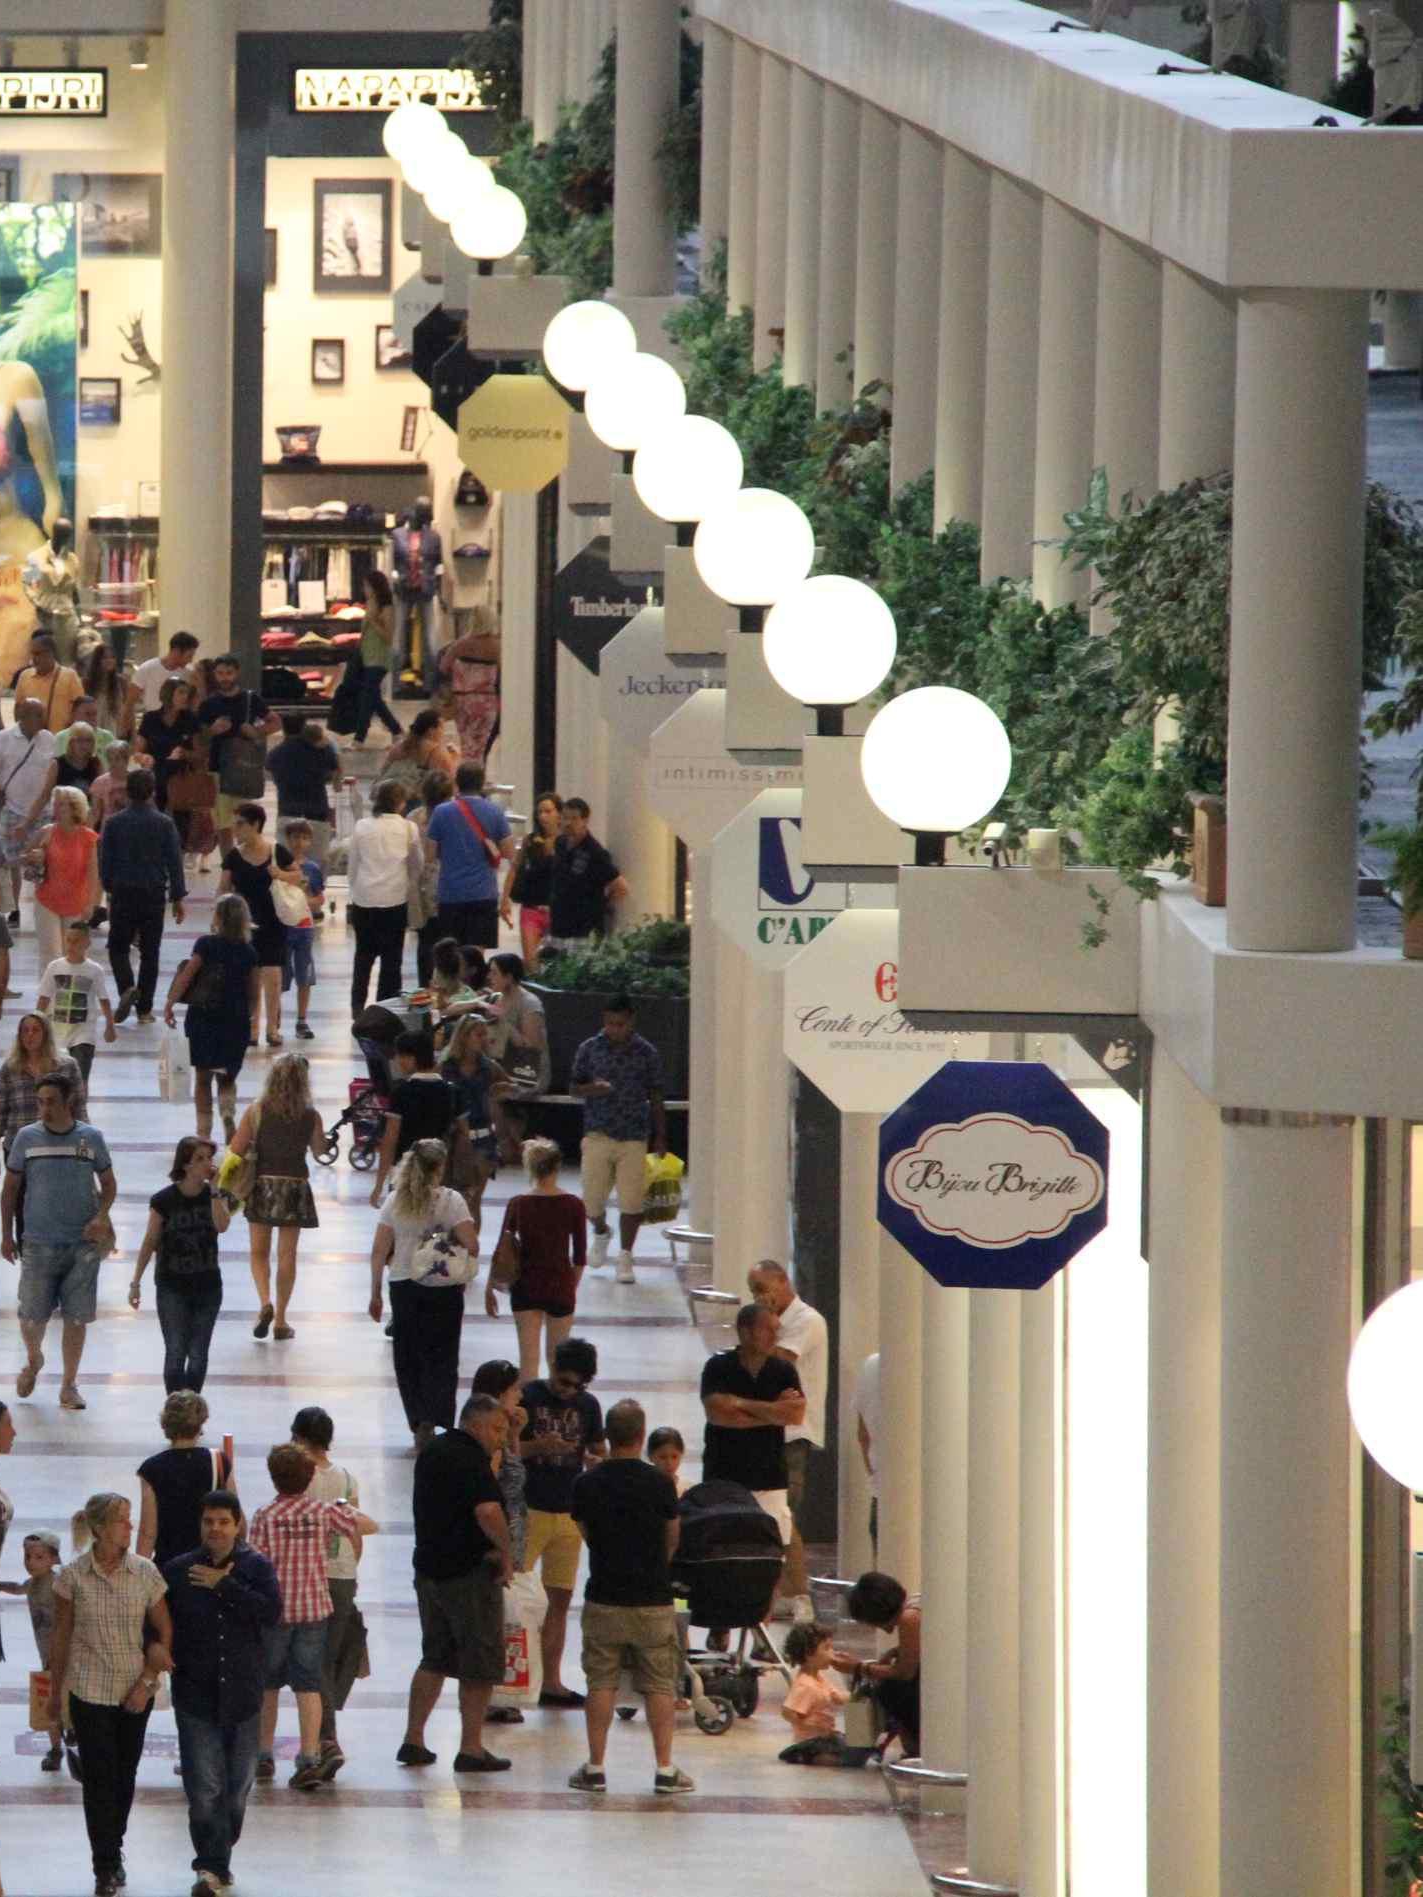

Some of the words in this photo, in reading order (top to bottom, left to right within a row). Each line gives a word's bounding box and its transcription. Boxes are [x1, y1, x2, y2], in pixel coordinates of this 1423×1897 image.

[794, 1006, 854, 1034] Conte
[905, 1159, 980, 1199] Bijou
[984, 1162, 1084, 1201] Brigitte
